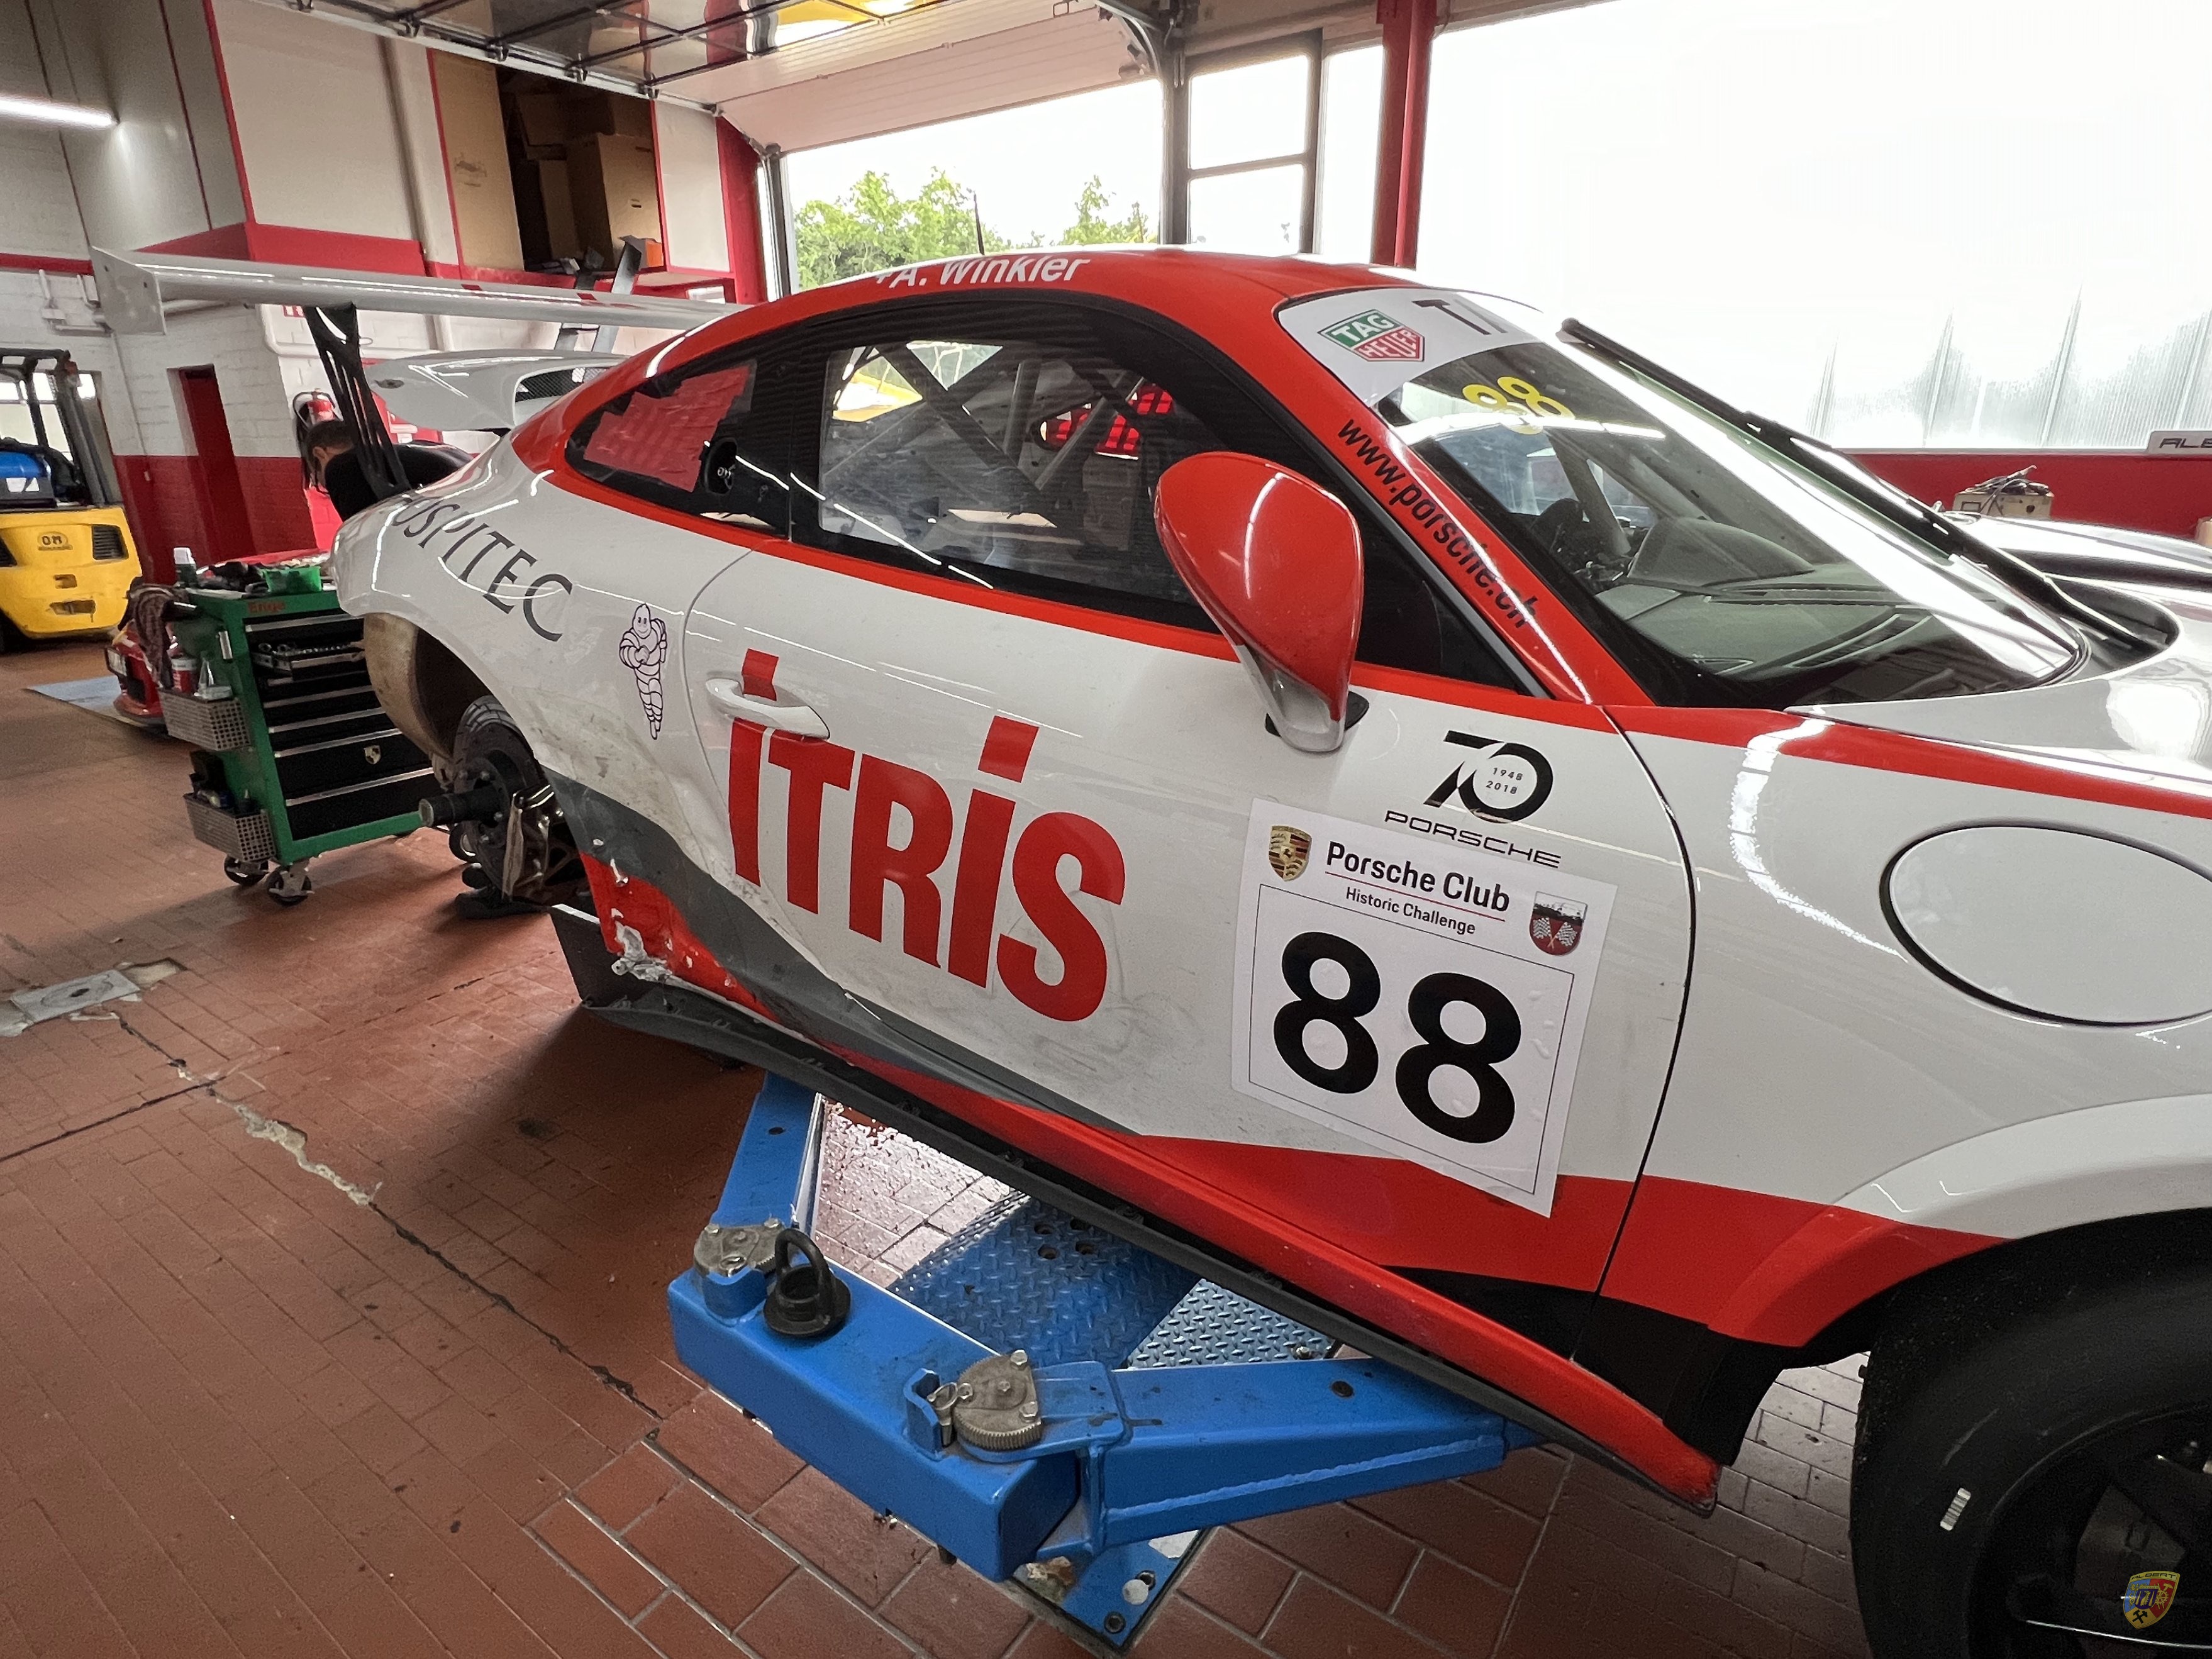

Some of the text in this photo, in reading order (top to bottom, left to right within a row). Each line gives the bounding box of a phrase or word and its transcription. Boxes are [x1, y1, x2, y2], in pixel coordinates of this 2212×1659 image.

[940, 255, 1091, 285] Winkler
[1331, 313, 1396, 343] TAG
[1358, 327, 1419, 358] HEUER
[1337, 419, 1538, 628] www.porsche.ch
[1486, 780, 1518, 794] 2018
[1492, 767, 1523, 781] 1948
[1385, 809, 1562, 869] PORSCHE
[1326, 841, 1510, 913] Porsche Club
[1345, 886, 1476, 935] Historic Challenge
[1274, 931, 1521, 1145] 88
